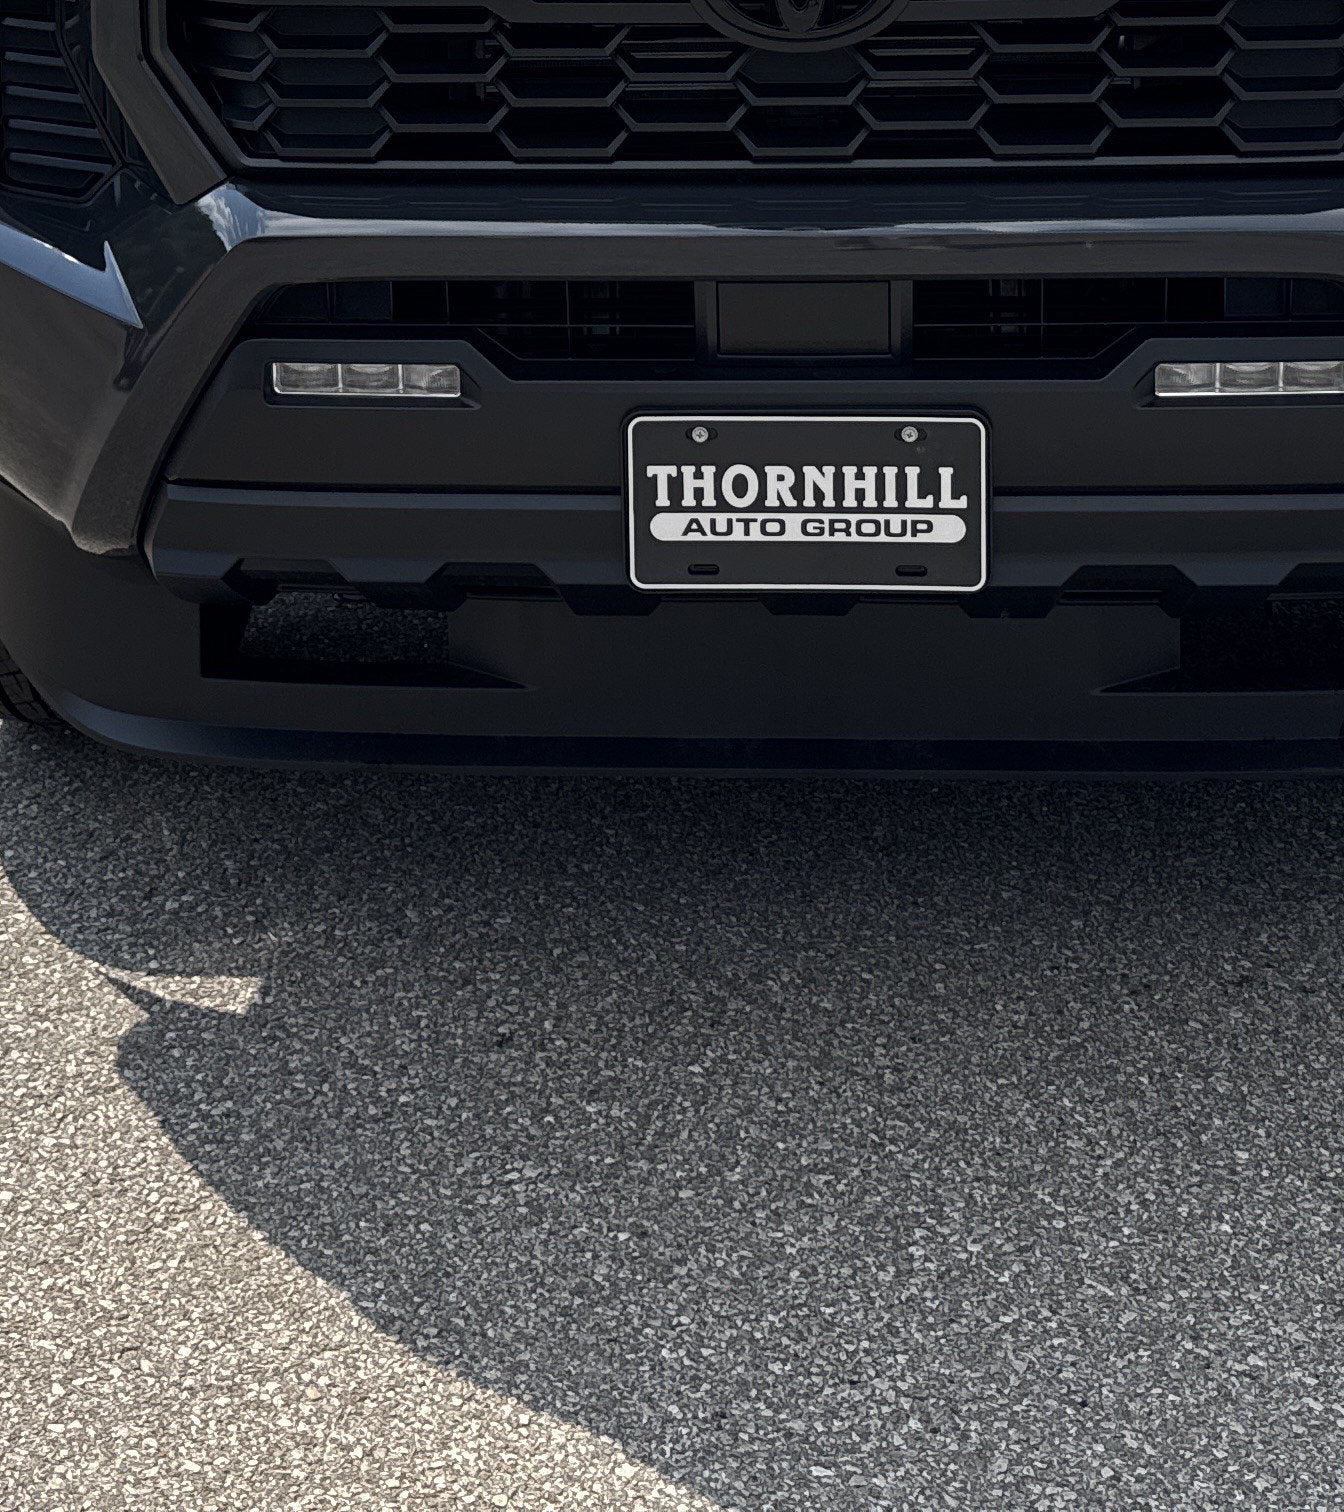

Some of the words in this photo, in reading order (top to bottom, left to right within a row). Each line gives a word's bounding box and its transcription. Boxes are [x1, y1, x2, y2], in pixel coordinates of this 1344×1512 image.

[646, 463, 968, 509] THORNHILL
[681, 517, 786, 538] AUTO
[801, 518, 934, 538] GROUP
